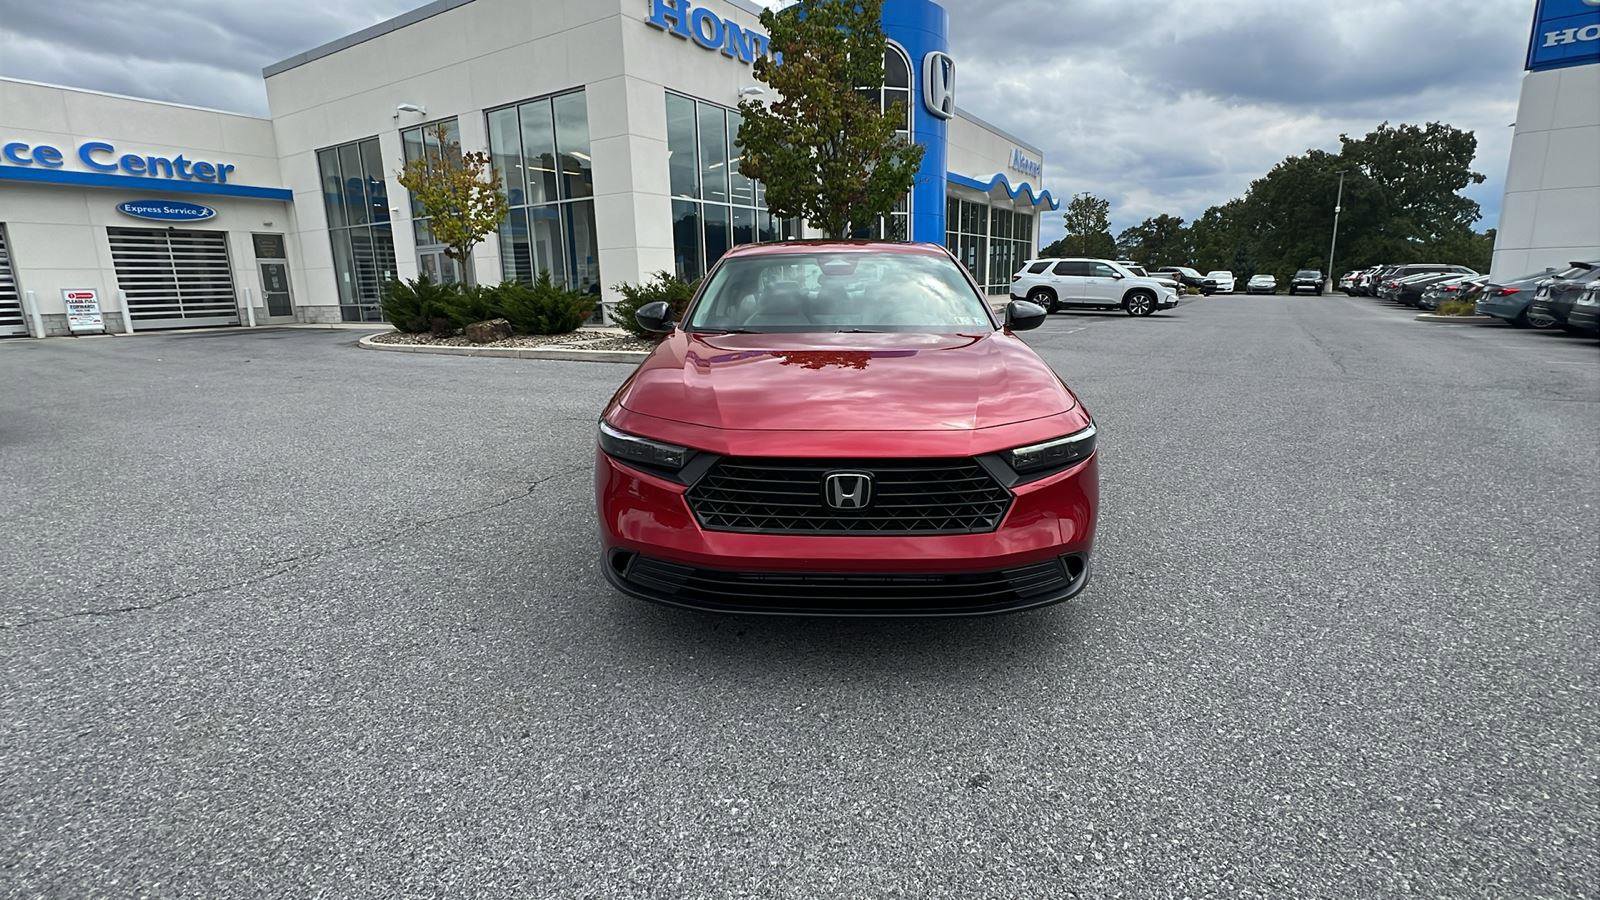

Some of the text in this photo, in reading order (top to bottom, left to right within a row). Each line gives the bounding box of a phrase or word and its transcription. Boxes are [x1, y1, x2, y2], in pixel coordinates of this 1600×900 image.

[0, 141, 235, 184] ce Center
[124, 204, 197, 215] Express Service
